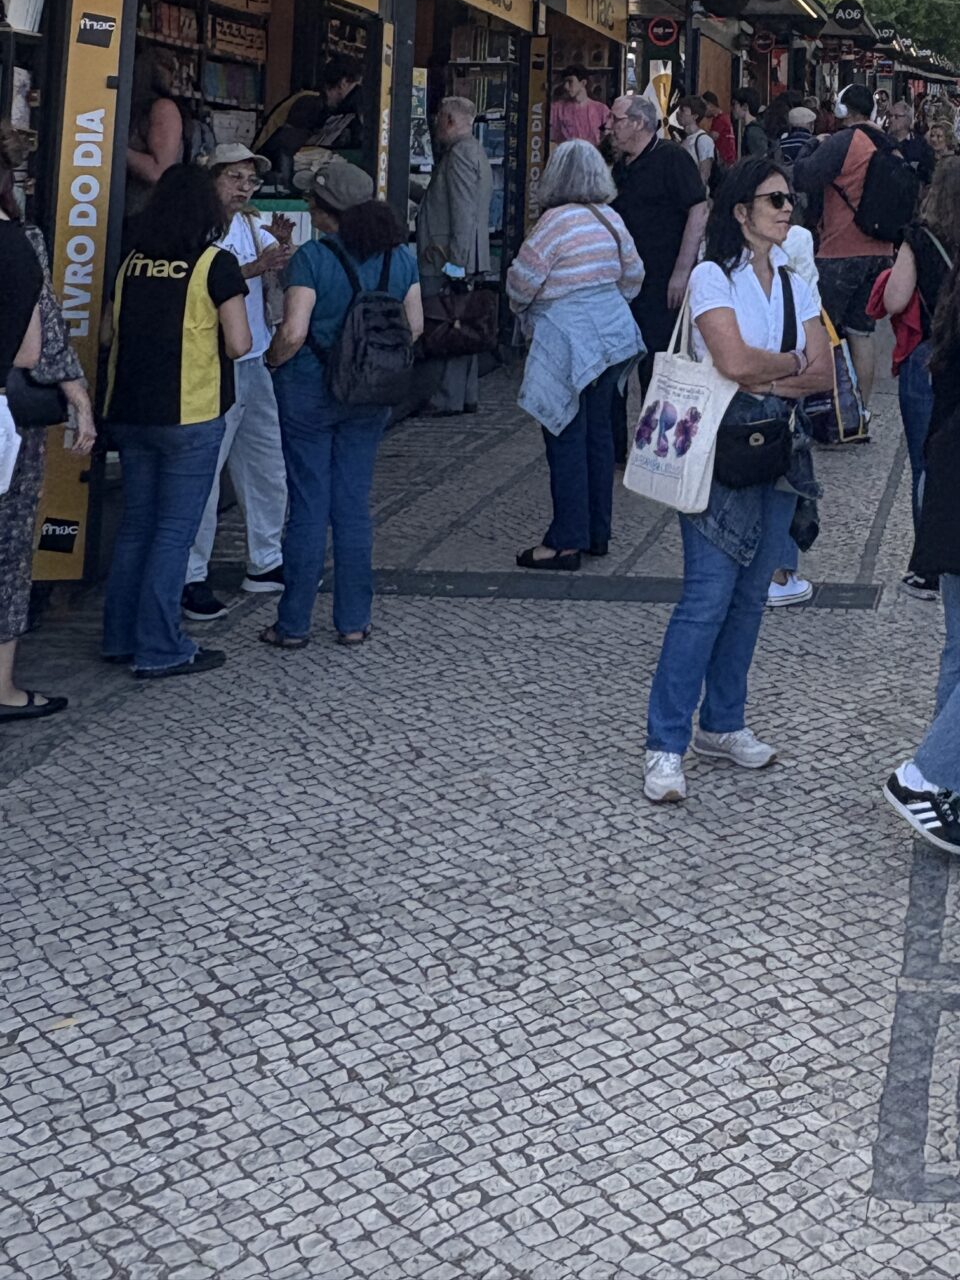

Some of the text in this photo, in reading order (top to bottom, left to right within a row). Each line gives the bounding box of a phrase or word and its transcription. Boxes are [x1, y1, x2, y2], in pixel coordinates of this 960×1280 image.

[836, 9, 861, 20] A06
[80, 18, 116, 31] fnac
[61, 108, 105, 337] LIVRO DO DIA
[127, 253, 189, 279] fnac
[42, 523, 80, 535] fnac
